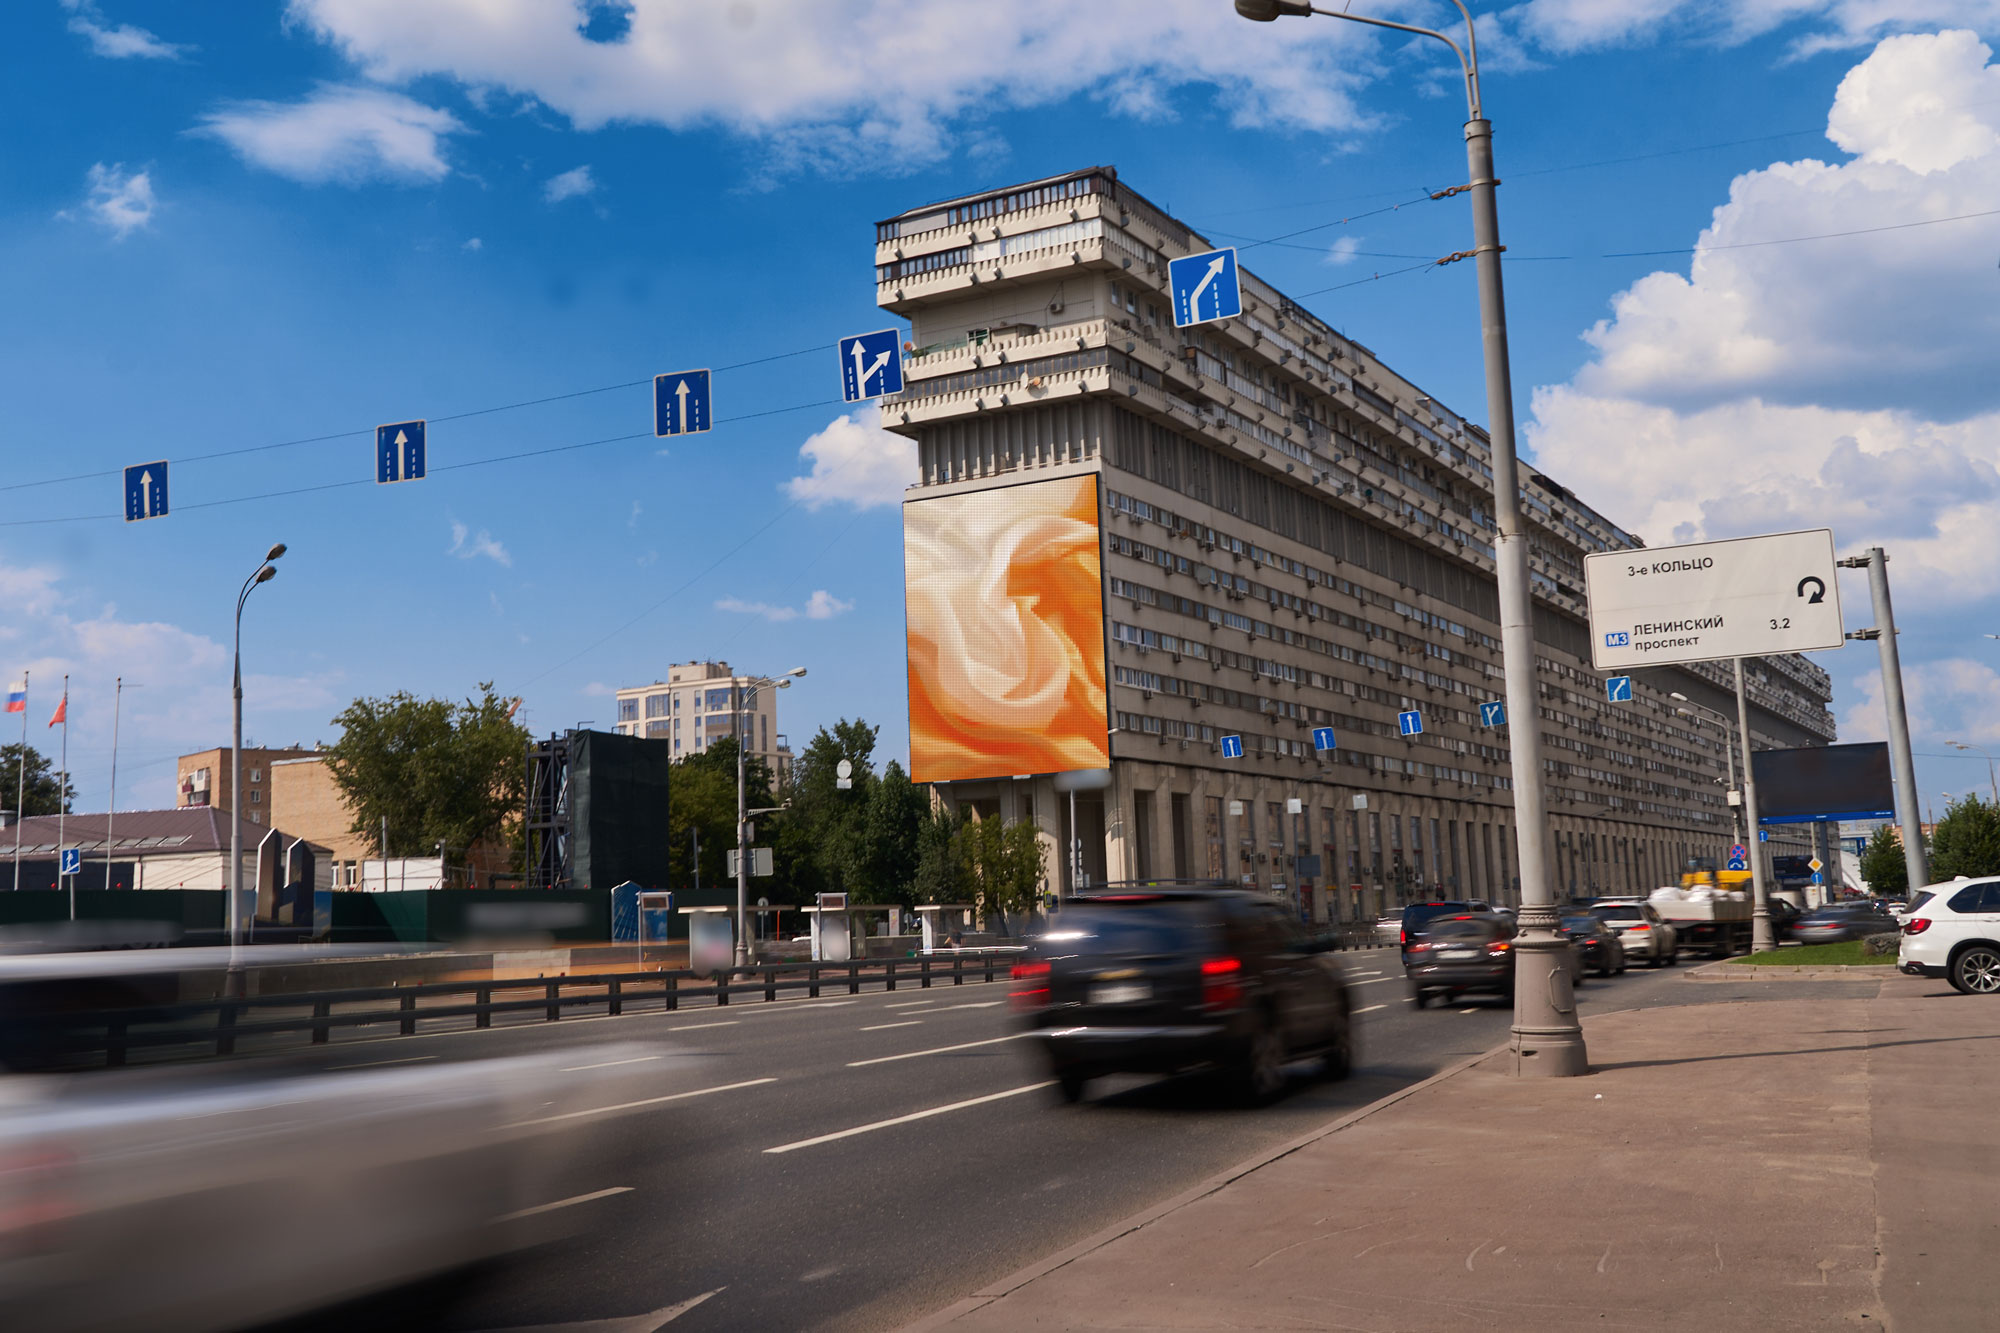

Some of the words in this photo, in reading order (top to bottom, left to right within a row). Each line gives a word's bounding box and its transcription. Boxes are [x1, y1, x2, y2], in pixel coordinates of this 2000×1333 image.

[1627, 565, 1648, 577] 3-е
[1652, 557, 1713, 574] КОЛЬЦО
[1633, 615, 1724, 636] ЛЕНИНСКИЙ
[1769, 617, 1791, 630] 3.2
[1607, 633, 1628, 646] М3
[1635, 636, 1700, 652] проспект
